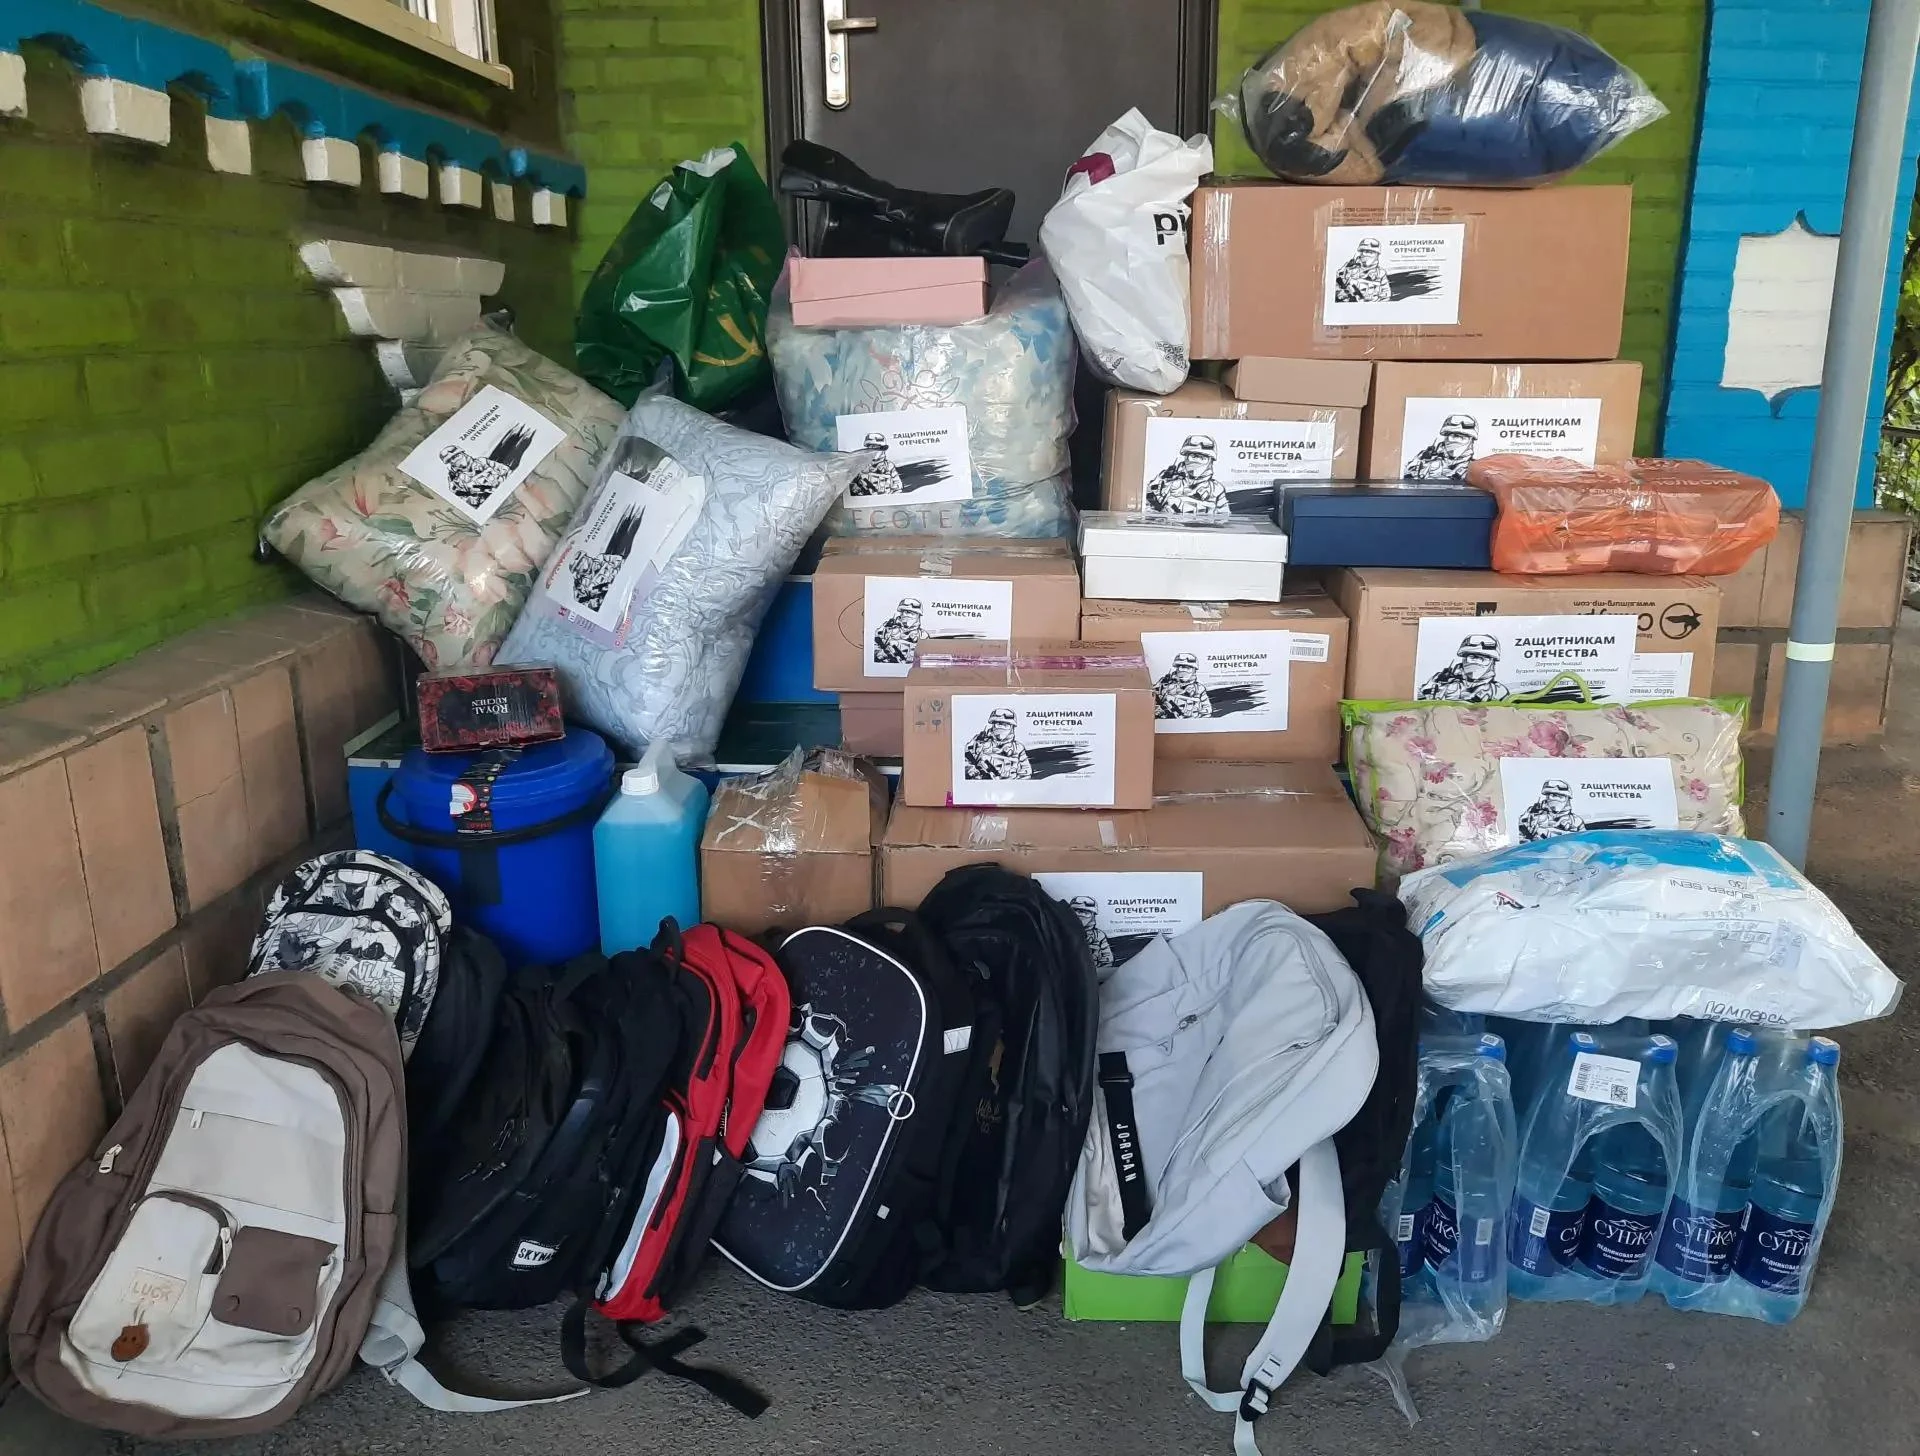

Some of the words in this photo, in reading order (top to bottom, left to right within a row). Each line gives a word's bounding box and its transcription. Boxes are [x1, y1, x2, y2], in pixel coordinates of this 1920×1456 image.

[1491, 418, 1582, 427] ZАЩИТНИКАМ
[1500, 430, 1566, 438] ОТЕЧЕСТВА
[899, 437, 941, 446] ОТЕЧЕСТВА
[1229, 440, 1316, 449] ZАЩИТНИКАМ
[1238, 451, 1302, 460] ОТЕЧЕСТВА
[930, 601, 992, 611] ZАЩИТНИКАМ
[1515, 636, 1615, 647] ZАЩИТНИКАМ
[1207, 653, 1267, 661] ZАЩИТНИКАМ
[1524, 648, 1598, 658] ОТЕЧЕСТВА
[472, 704, 508, 715] ROYAL
[1580, 783, 1652, 791] ZАЩИТНИКАМ
[1589, 791, 1642, 799] ОТЕЧЕСТВА
[1107, 898, 1177, 906] ZАЩИТНИКАМ
